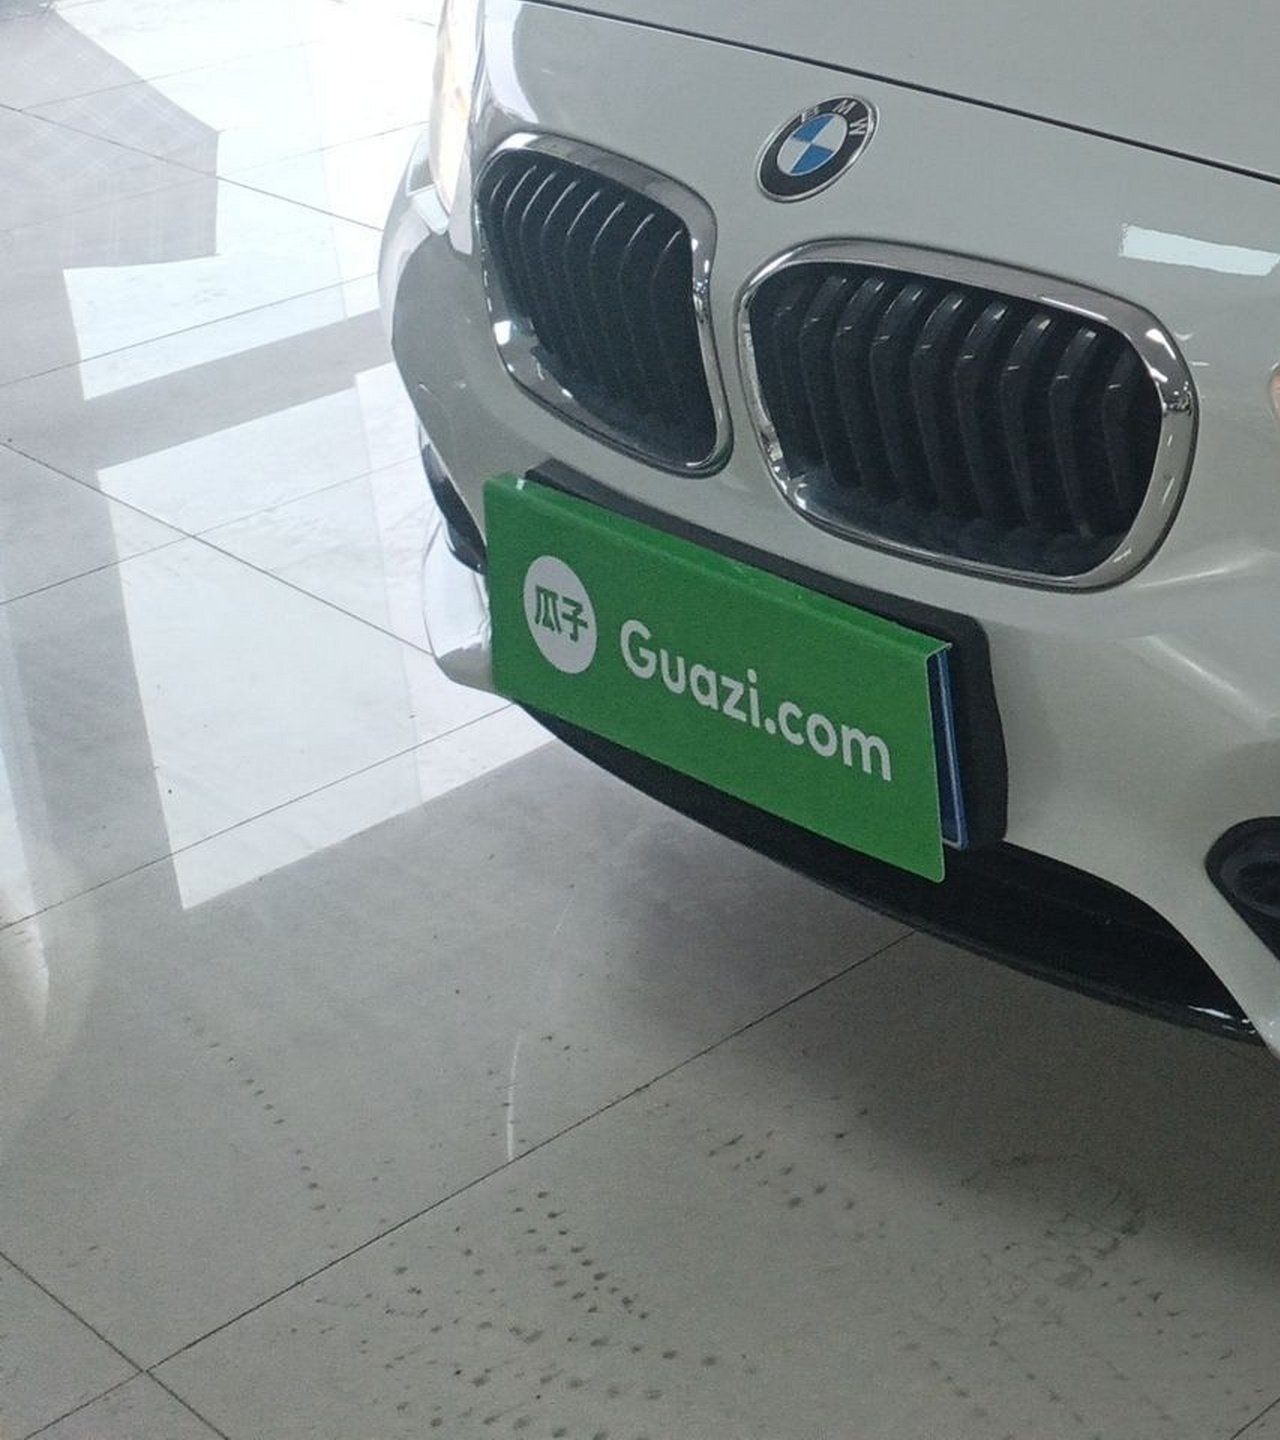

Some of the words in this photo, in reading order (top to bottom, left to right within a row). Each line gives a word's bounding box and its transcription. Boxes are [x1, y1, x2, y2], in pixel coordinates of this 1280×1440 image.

[800, 98, 870, 137] BMW
[535, 586, 589, 642] 瓜子
[619, 619, 893, 782] Guazi.com
